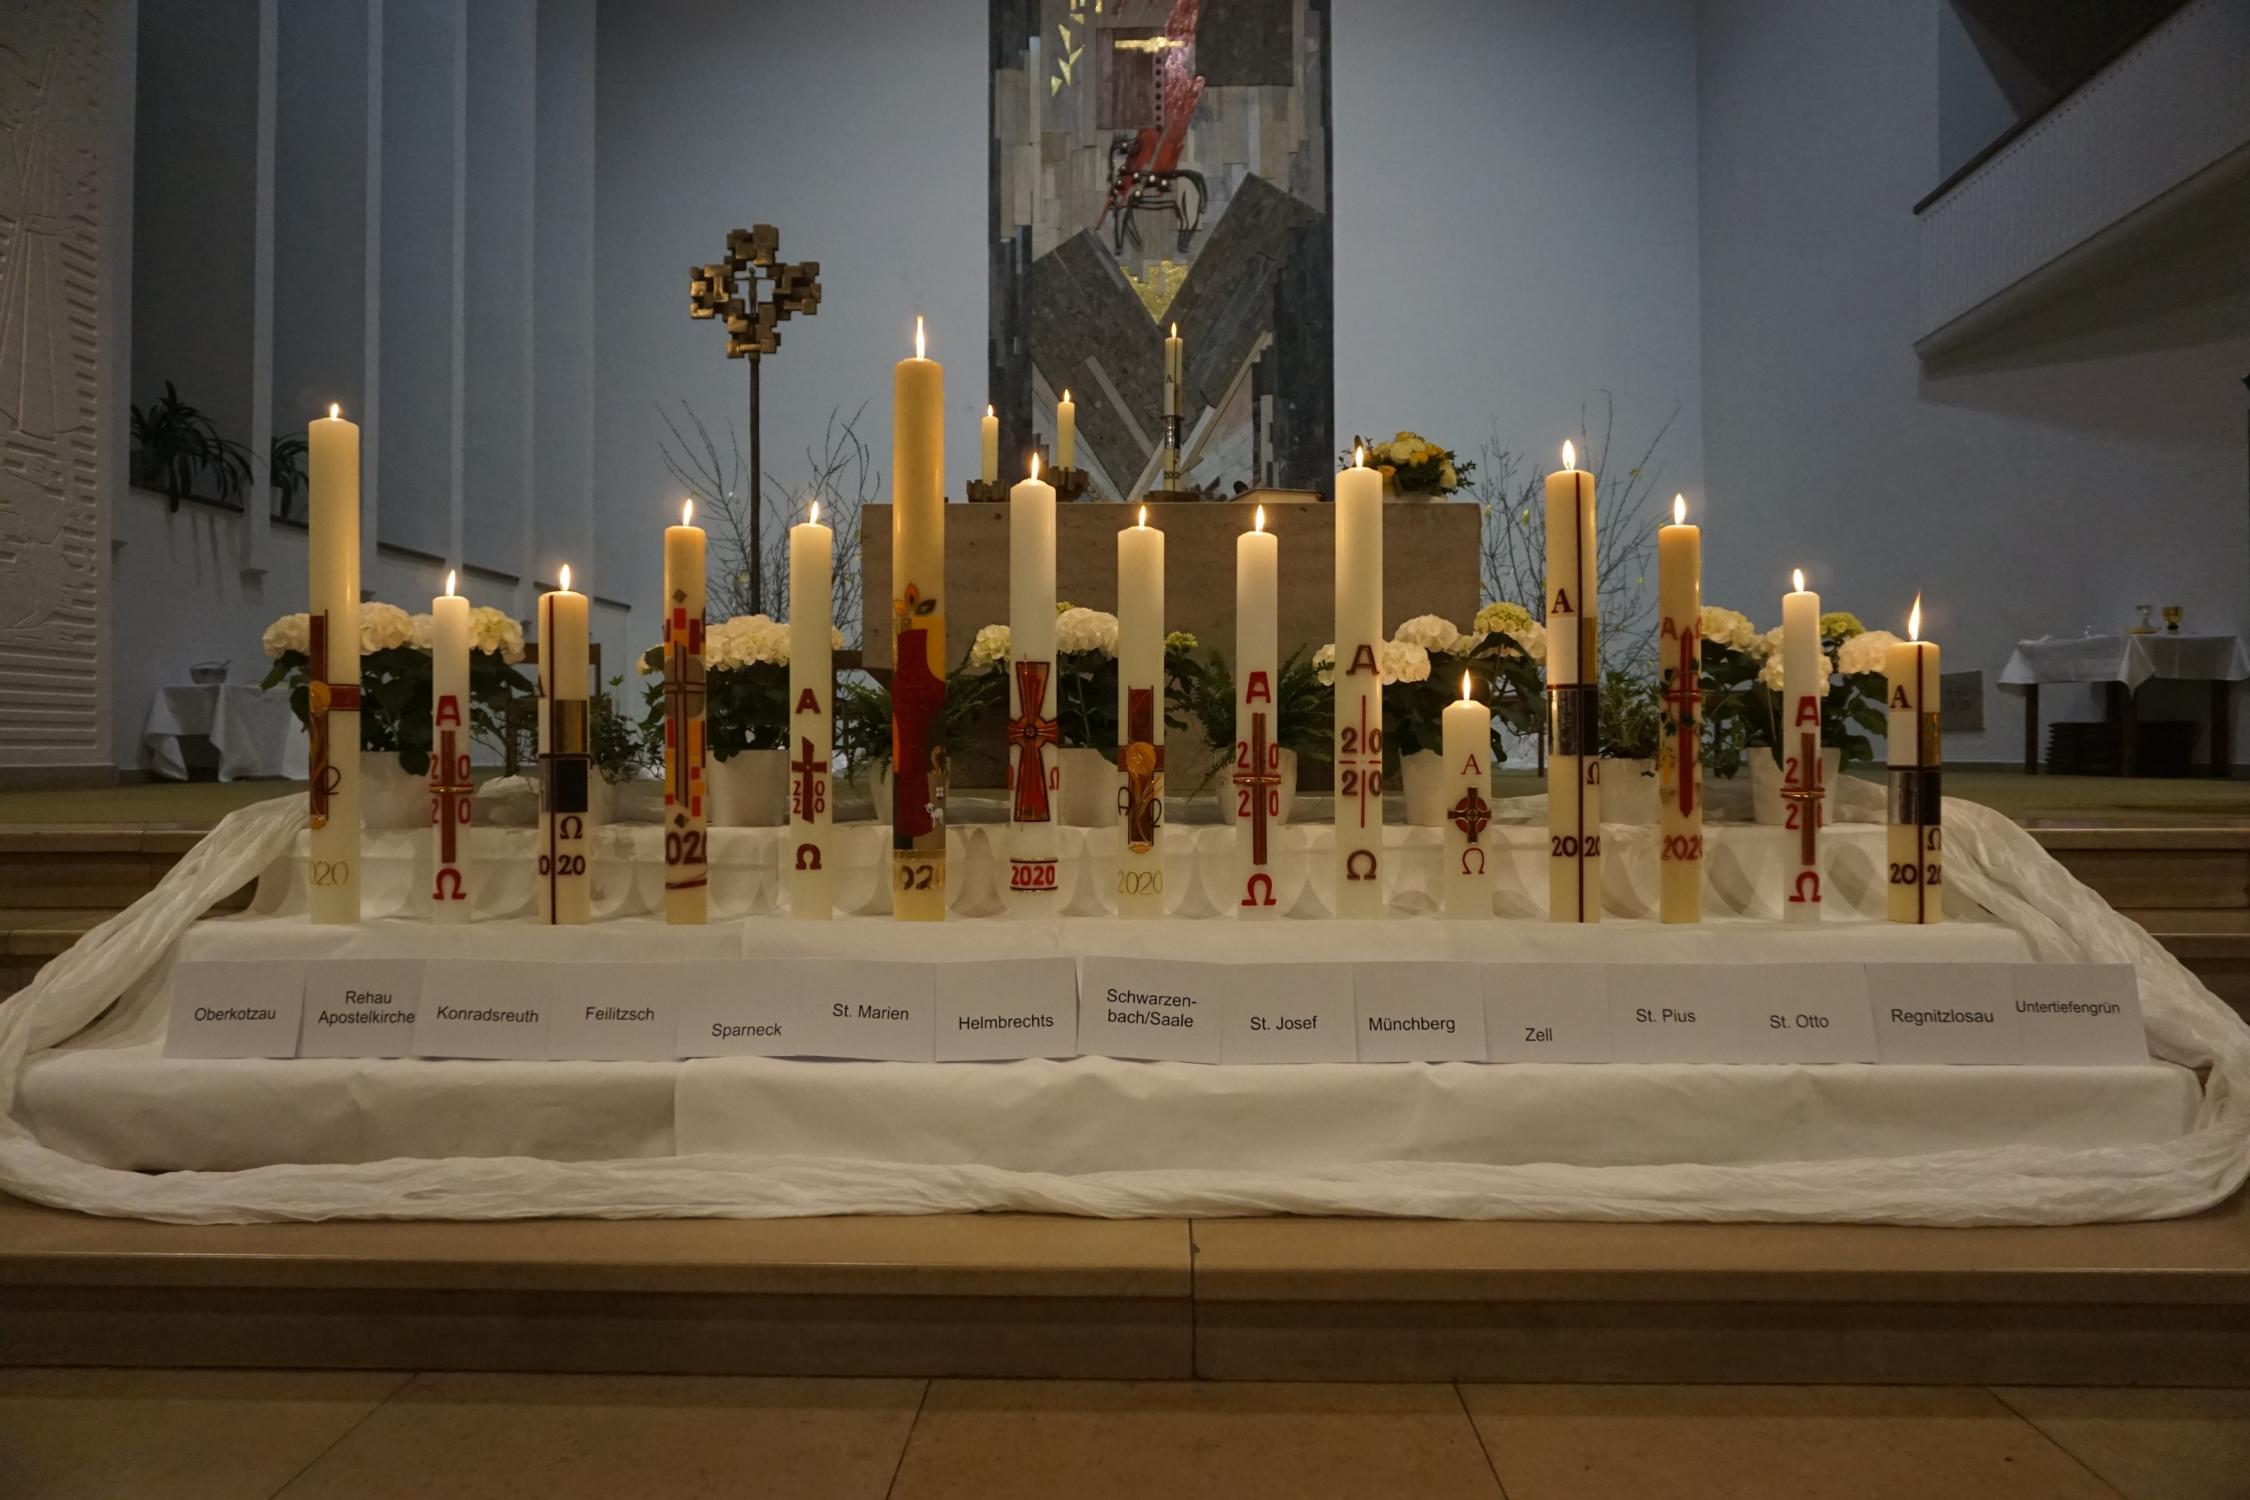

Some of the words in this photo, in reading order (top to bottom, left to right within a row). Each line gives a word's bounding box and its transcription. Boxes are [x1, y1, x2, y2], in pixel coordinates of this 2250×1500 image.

[1551, 589, 1574, 613] A
[1346, 645, 1379, 675] A
[1246, 672, 1271, 704] A
[1890, 685, 1912, 708] A
[796, 688, 821, 714] A
[436, 695, 461, 726] A
[1796, 697, 1820, 727] A
[1461, 754, 1482, 775] A
[1011, 864, 1056, 886] 2020
[1118, 870, 1163, 896] 2020
[345, 990, 392, 1005] Rehau
[1106, 988, 1198, 1008] Schwarzen-
[194, 1007, 276, 1022] Oberkotzau
[436, 1005, 539, 1023] Konradsreuth
[585, 1006, 655, 1021] Feilitzsch
[832, 1003, 853, 1019] St.
[857, 1004, 909, 1021] Marien
[1636, 1008, 1657, 1023] St.
[1662, 1008, 1697, 1023] Pius
[1891, 1008, 1994, 1027] Regnitzlosau
[2015, 1000, 2121, 1017] Untertiefengrün
[318, 1010, 416, 1027] Apostelkirche
[958, 1013, 1055, 1031] Helmbrechts
[1107, 1008, 1194, 1028] bach/Saale
[1250, 1016, 1271, 1031] St.
[1275, 1015, 1318, 1030] Josef
[1368, 1016, 1456, 1034] Münchberg
[1769, 1014, 1790, 1029] St.
[1796, 1014, 1830, 1029] Otto
[711, 1022, 782, 1040] Sparneck
[1525, 1027, 1553, 1042] Zell
